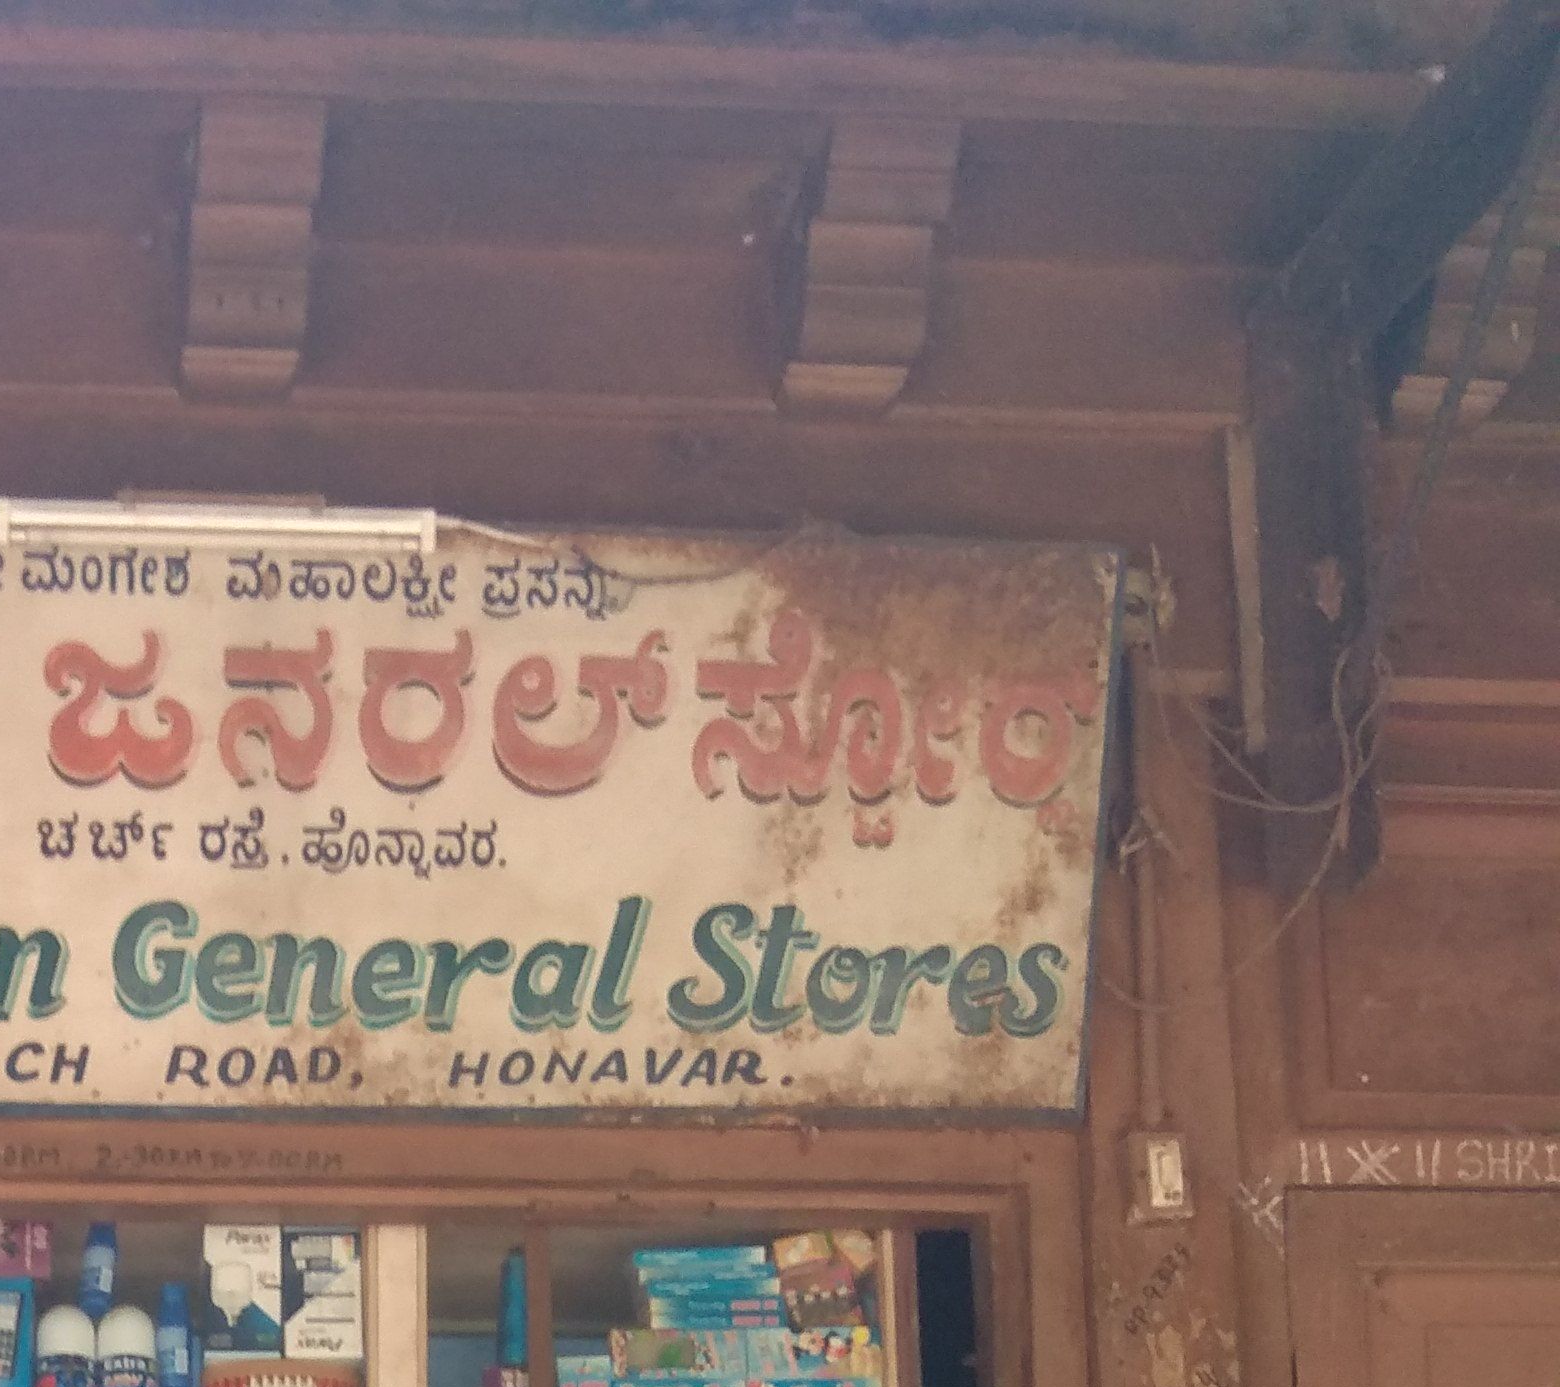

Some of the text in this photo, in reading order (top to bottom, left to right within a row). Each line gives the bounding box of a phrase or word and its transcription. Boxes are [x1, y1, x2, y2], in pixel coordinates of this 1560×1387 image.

[44, 620, 669, 800] ಜನರಲ್
[113, 896, 650, 1034] General
[667, 903, 1070, 1039] Stores
[165, 1046, 364, 1090] ROAD,
[449, 1048, 796, 1089] HONAVAR.
[1456, 1139, 1560, 1182] SHRI
